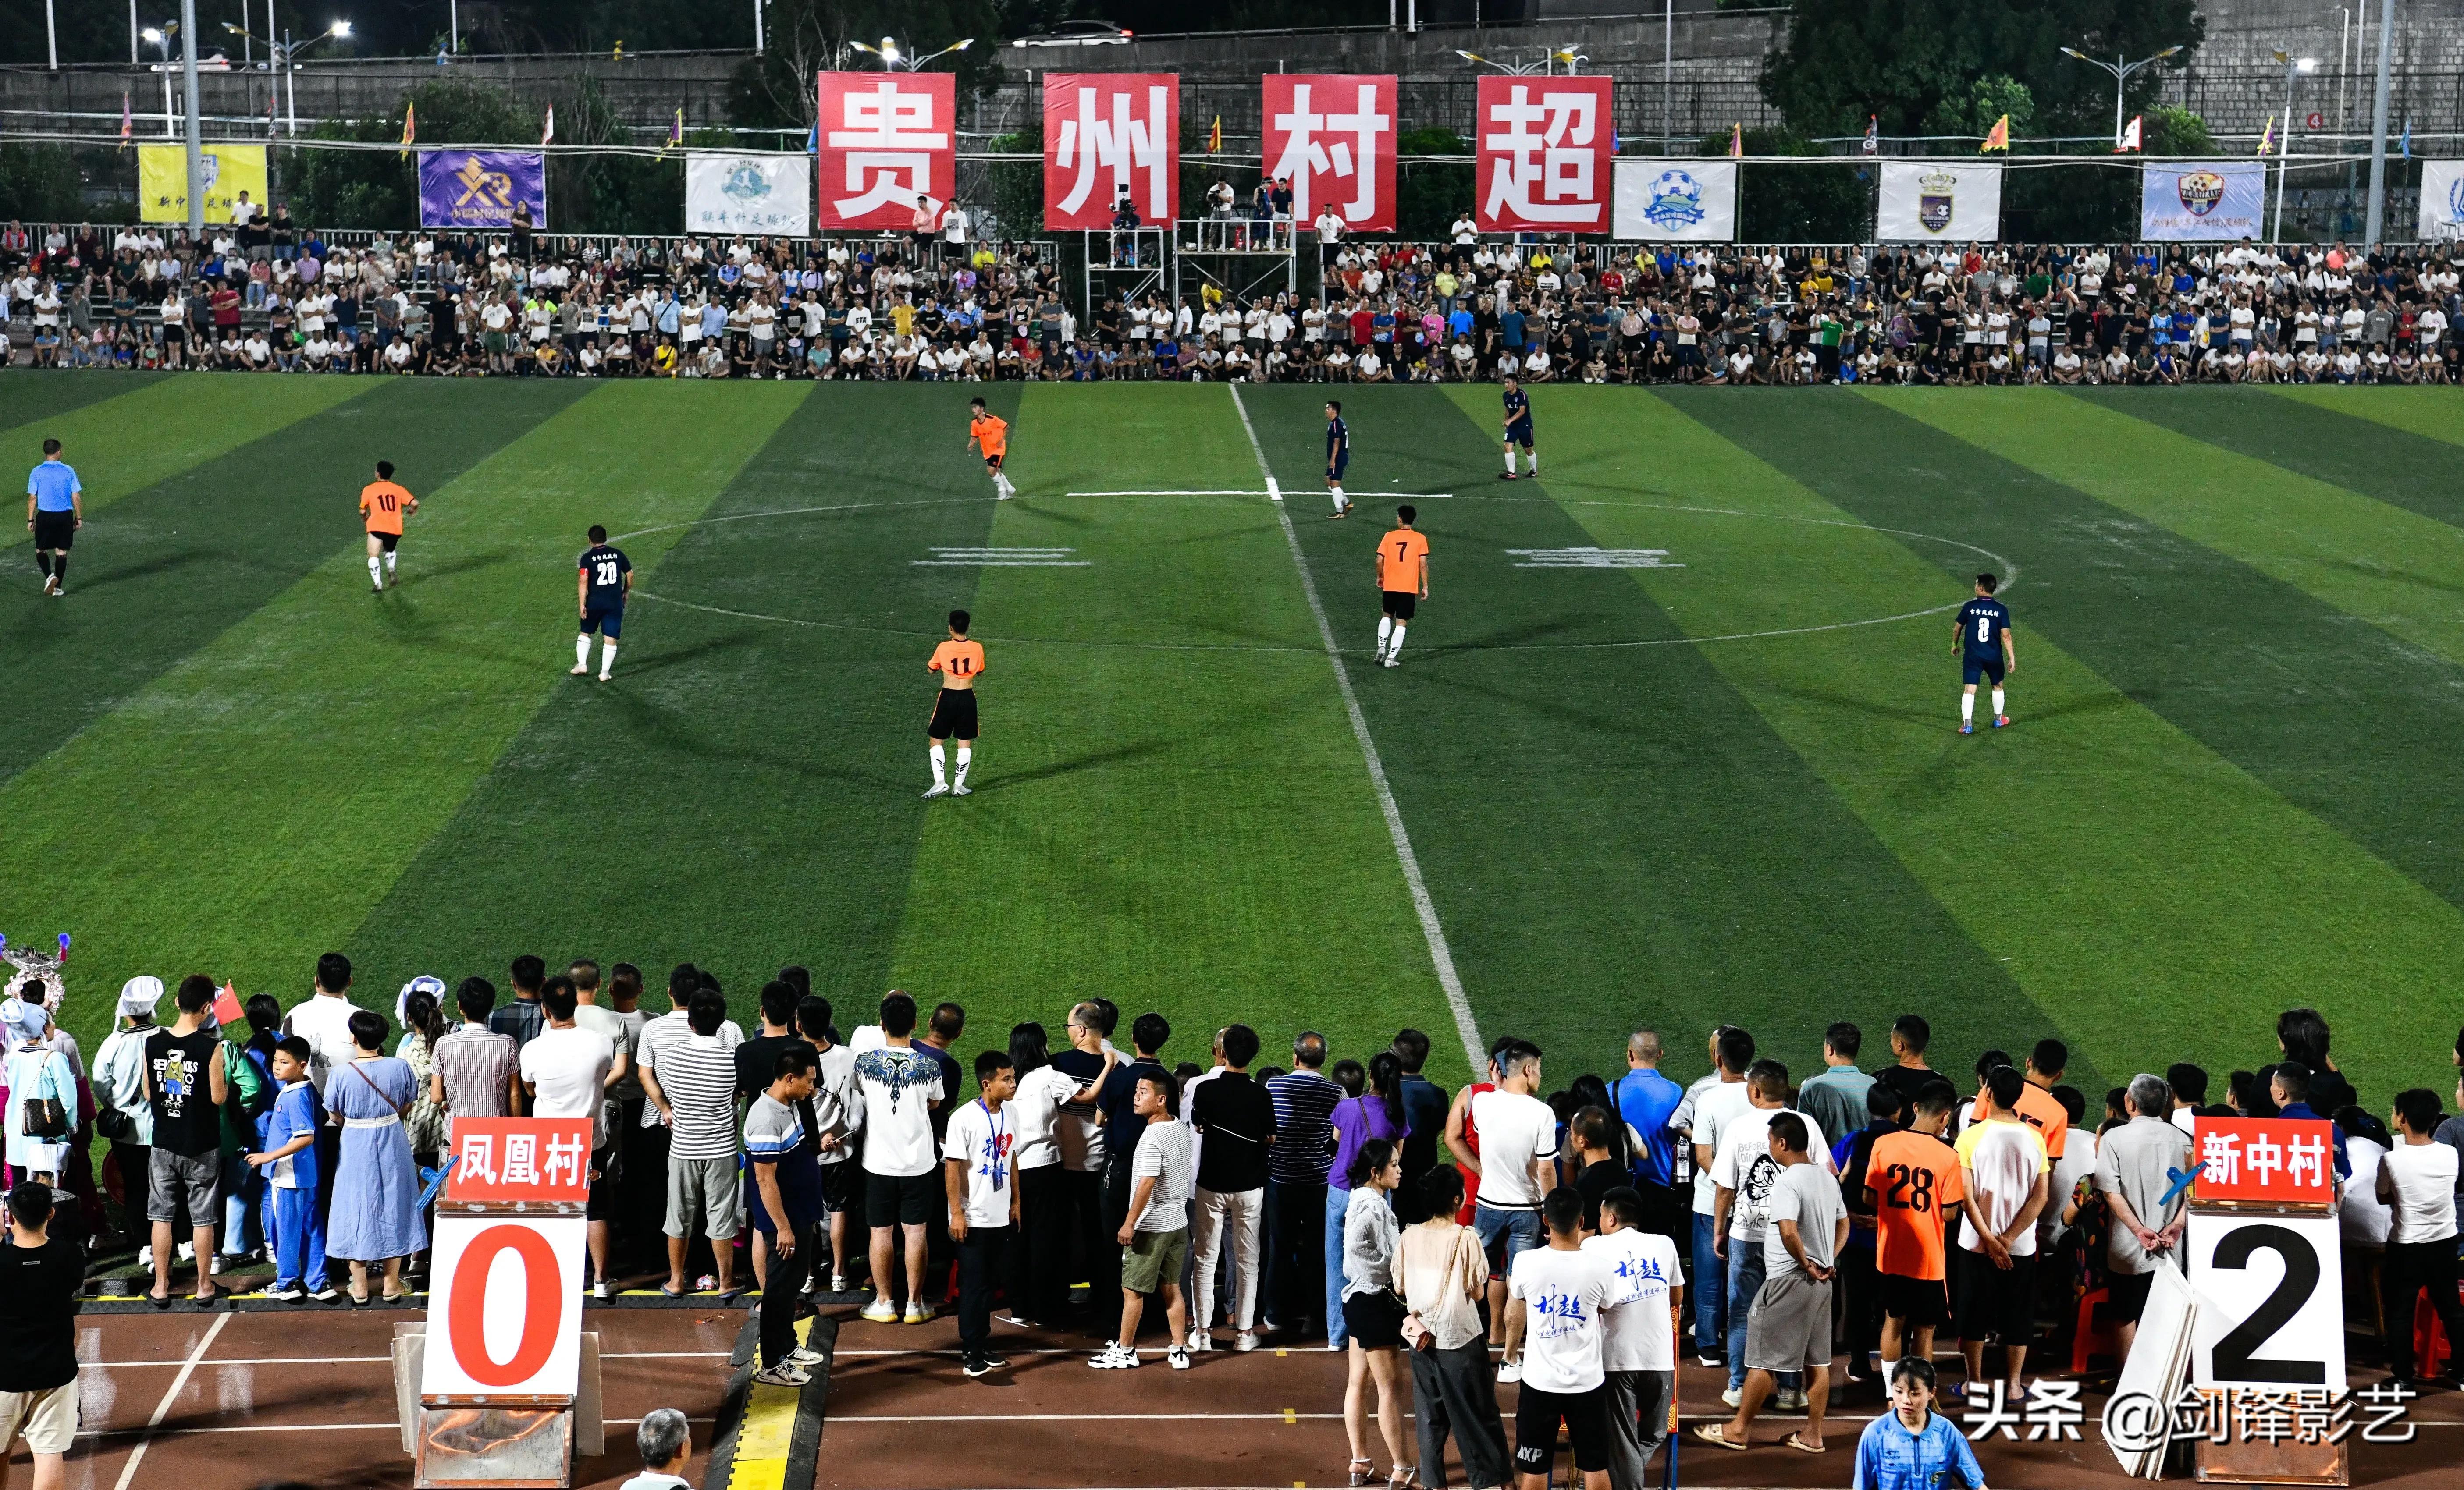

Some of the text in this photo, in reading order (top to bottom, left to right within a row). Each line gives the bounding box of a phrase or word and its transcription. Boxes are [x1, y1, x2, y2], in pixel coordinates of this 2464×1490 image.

[2311, 115, 2320, 127] 4
[377, 494, 396, 512] 10
[1396, 542, 1408, 562] 7
[597, 561, 617, 585] 20
[1978, 618, 1989, 642] 8
[951, 658, 970, 675] 11
[457, 1133, 583, 1186] 凤凰村
[2202, 1132, 2325, 1188] 新中村
[1887, 1164, 1934, 1213] 28
[1614, 1251, 1667, 1291] 村超
[448, 1224, 562, 1387] 0
[1533, 1284, 1586, 1329] 村超
[2212, 1224, 2325, 1384] 2
